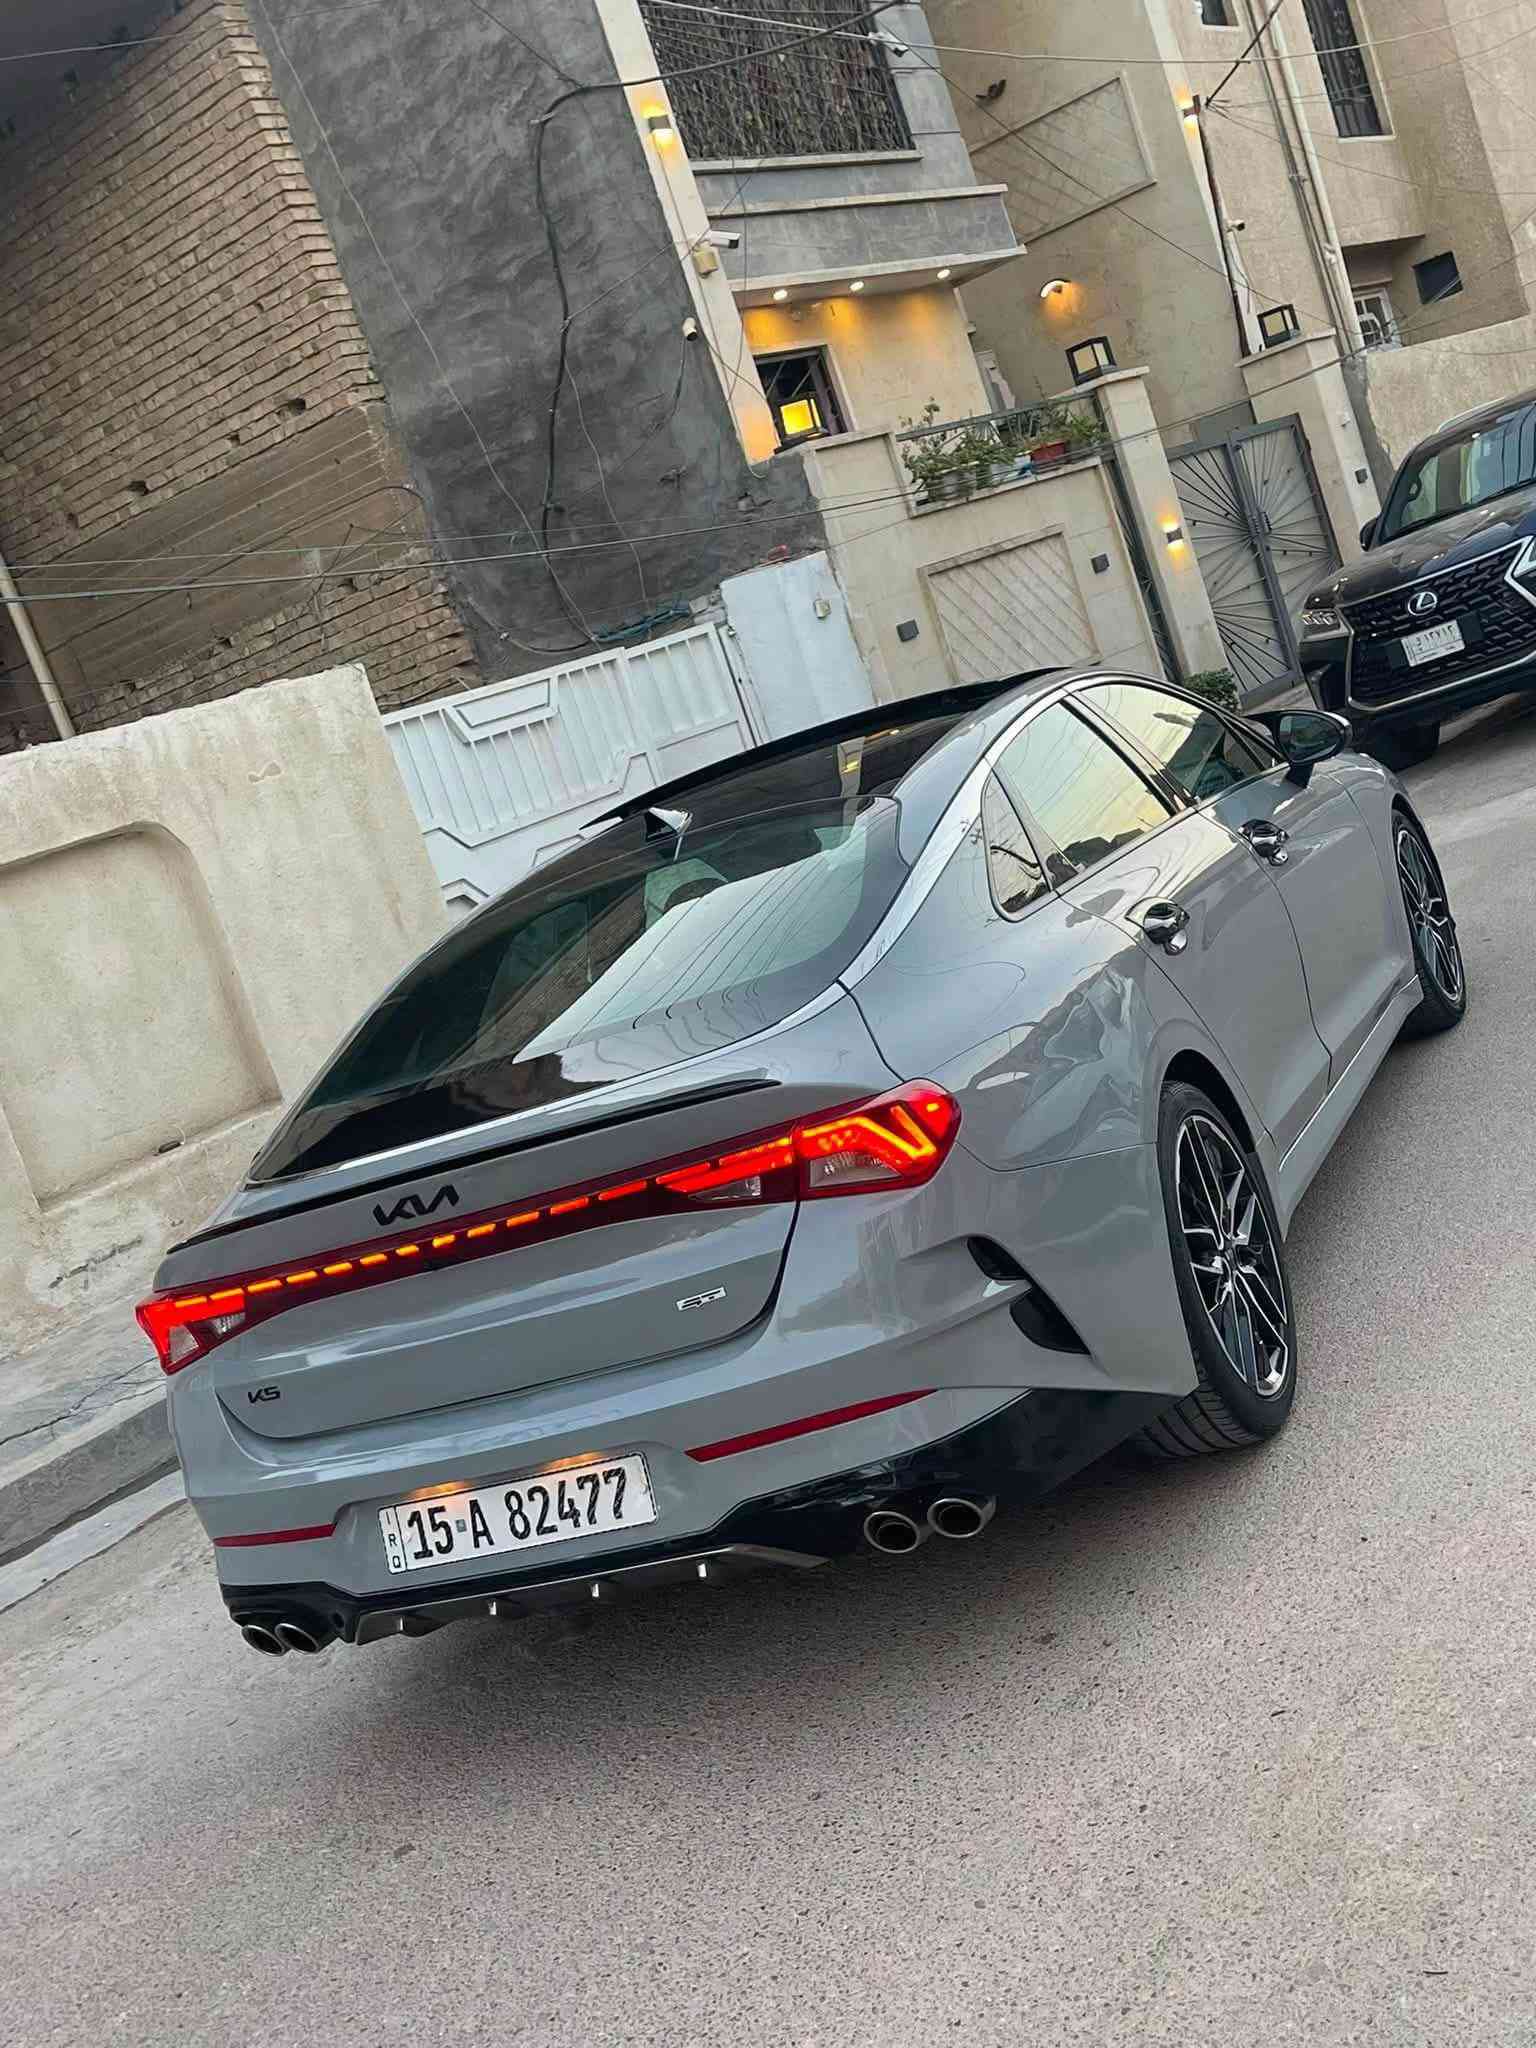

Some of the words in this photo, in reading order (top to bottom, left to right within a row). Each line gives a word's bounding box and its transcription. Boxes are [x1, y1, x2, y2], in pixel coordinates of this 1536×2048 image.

[247, 1385, 281, 1404] K5
[407, 1505, 454, 1560] 15
[469, 1498, 495, 1549] A
[504, 1466, 626, 1540] 82477
